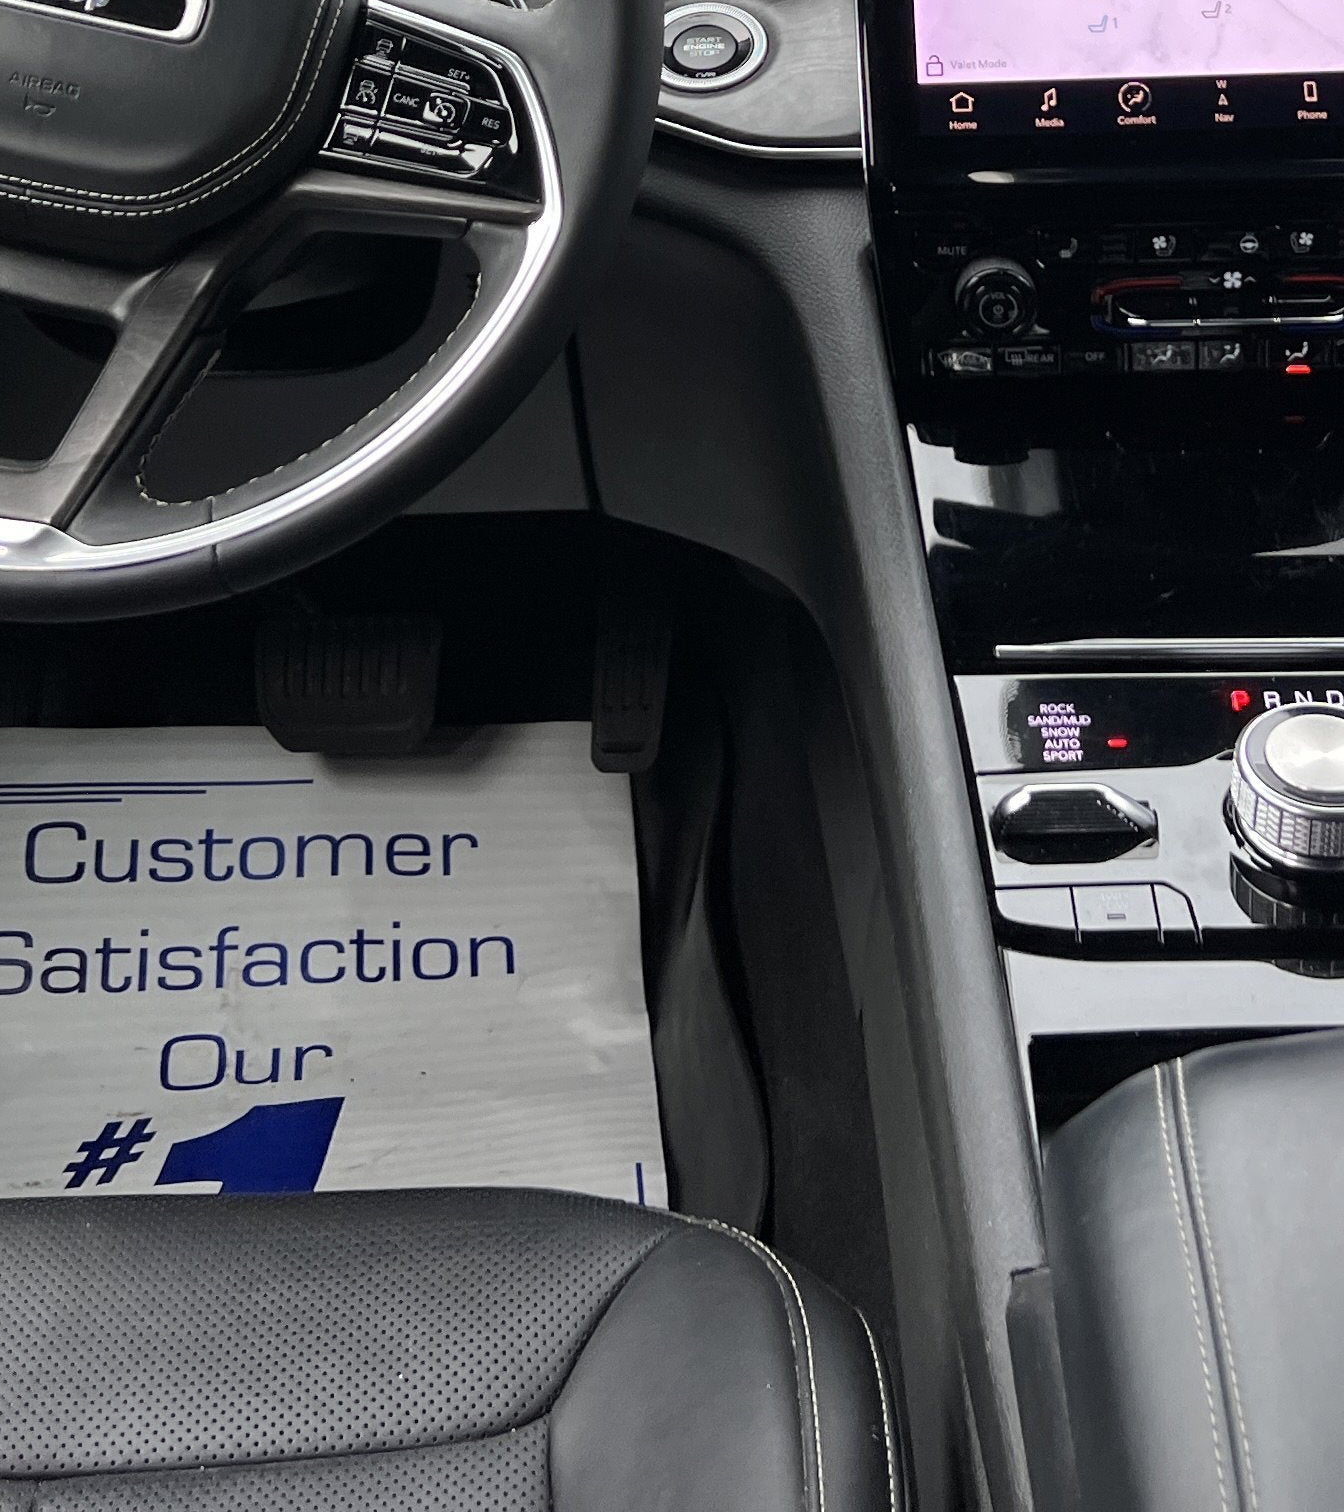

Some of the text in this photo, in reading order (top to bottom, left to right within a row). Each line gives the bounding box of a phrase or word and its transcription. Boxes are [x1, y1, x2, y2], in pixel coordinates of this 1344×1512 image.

[686, 36, 722, 44] START
[683, 42, 726, 51] ENGINE
[950, 58, 1007, 70] Valet Mode
[9, 72, 80, 100] AIRBAG
[393, 92, 421, 108] CANC
[481, 116, 501, 130] RES
[949, 120, 978, 131] Home
[1034, 117, 1065, 128] Media
[1117, 113, 1157, 126] Comfort
[1214, 112, 1234, 123] Nav
[1296, 109, 1328, 120] Phone
[937, 245, 967, 256] MUTE
[1085, 351, 1105, 362] OFF
[1231, 690, 1250, 711] P
[1263, 691, 1281, 708] R
[1326, 690, 1344, 706] D
[1039, 703, 1075, 715] ROCK
[1027, 714, 1091, 726] SAND/MUD
[1041, 726, 1080, 738] SNOW
[1044, 738, 1080, 750] AUTO
[1043, 749, 1084, 762] SPORT
[23, 820, 479, 884] Customer
[158, 1034, 334, 1091] Our
